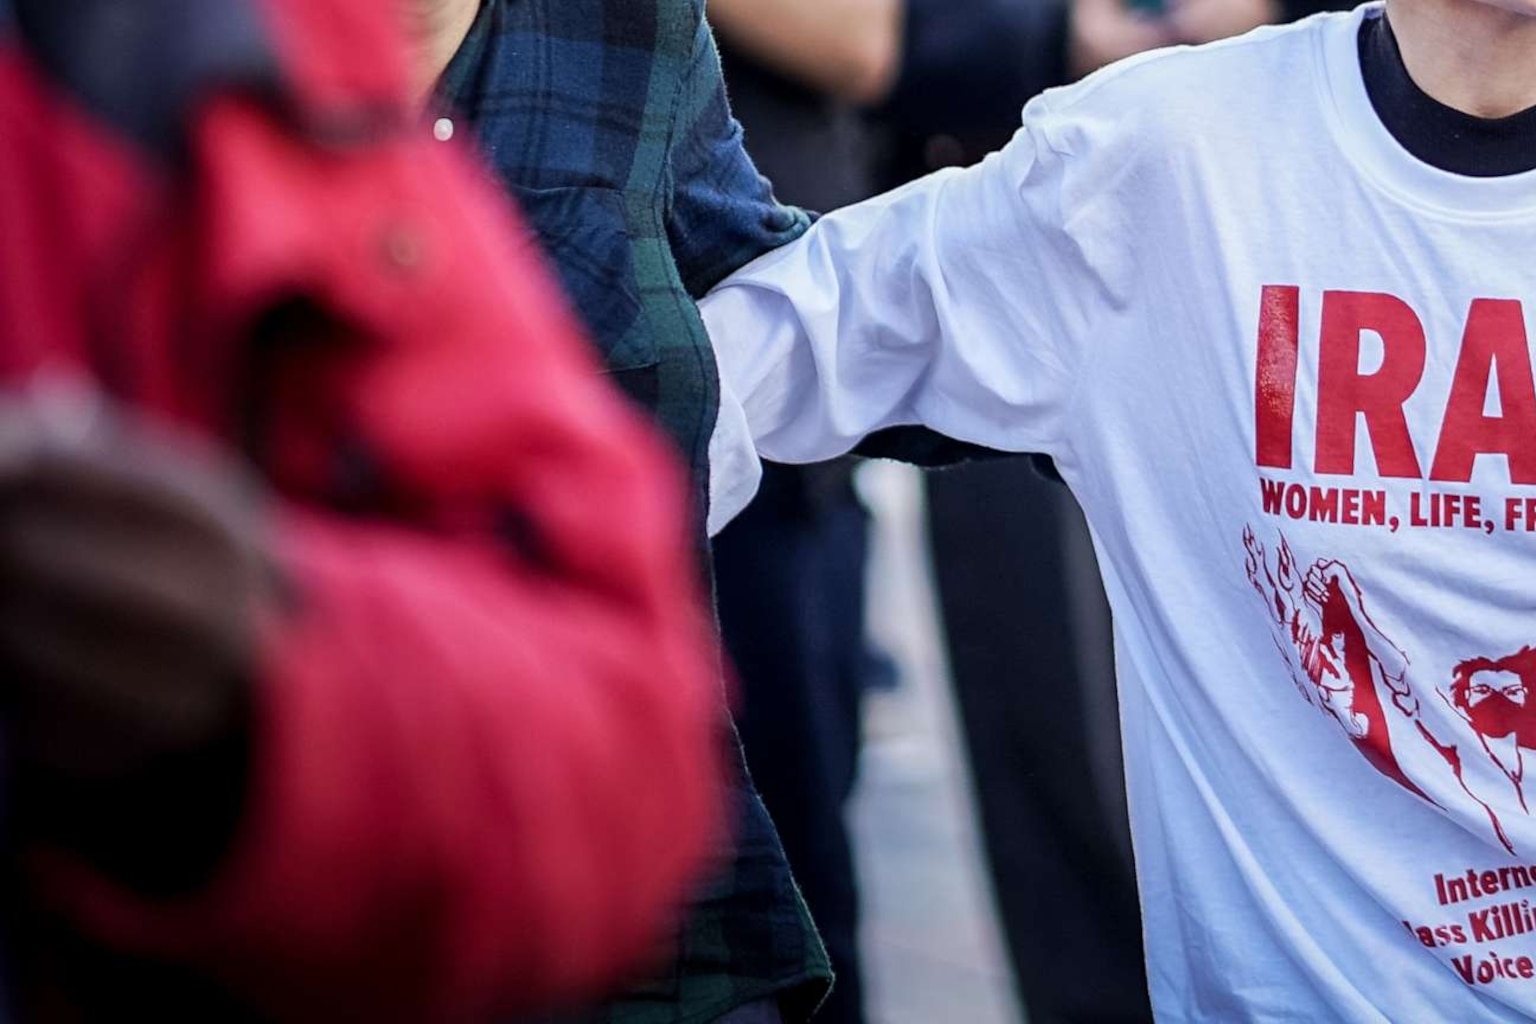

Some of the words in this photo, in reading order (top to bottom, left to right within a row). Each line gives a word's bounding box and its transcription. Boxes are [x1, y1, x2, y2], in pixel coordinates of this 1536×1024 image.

[1259, 478, 1399, 532] WOMEN,
[1410, 492, 1494, 535] LIFE,
[1403, 920, 1468, 949] ass
[1451, 951, 1534, 985] Voice
